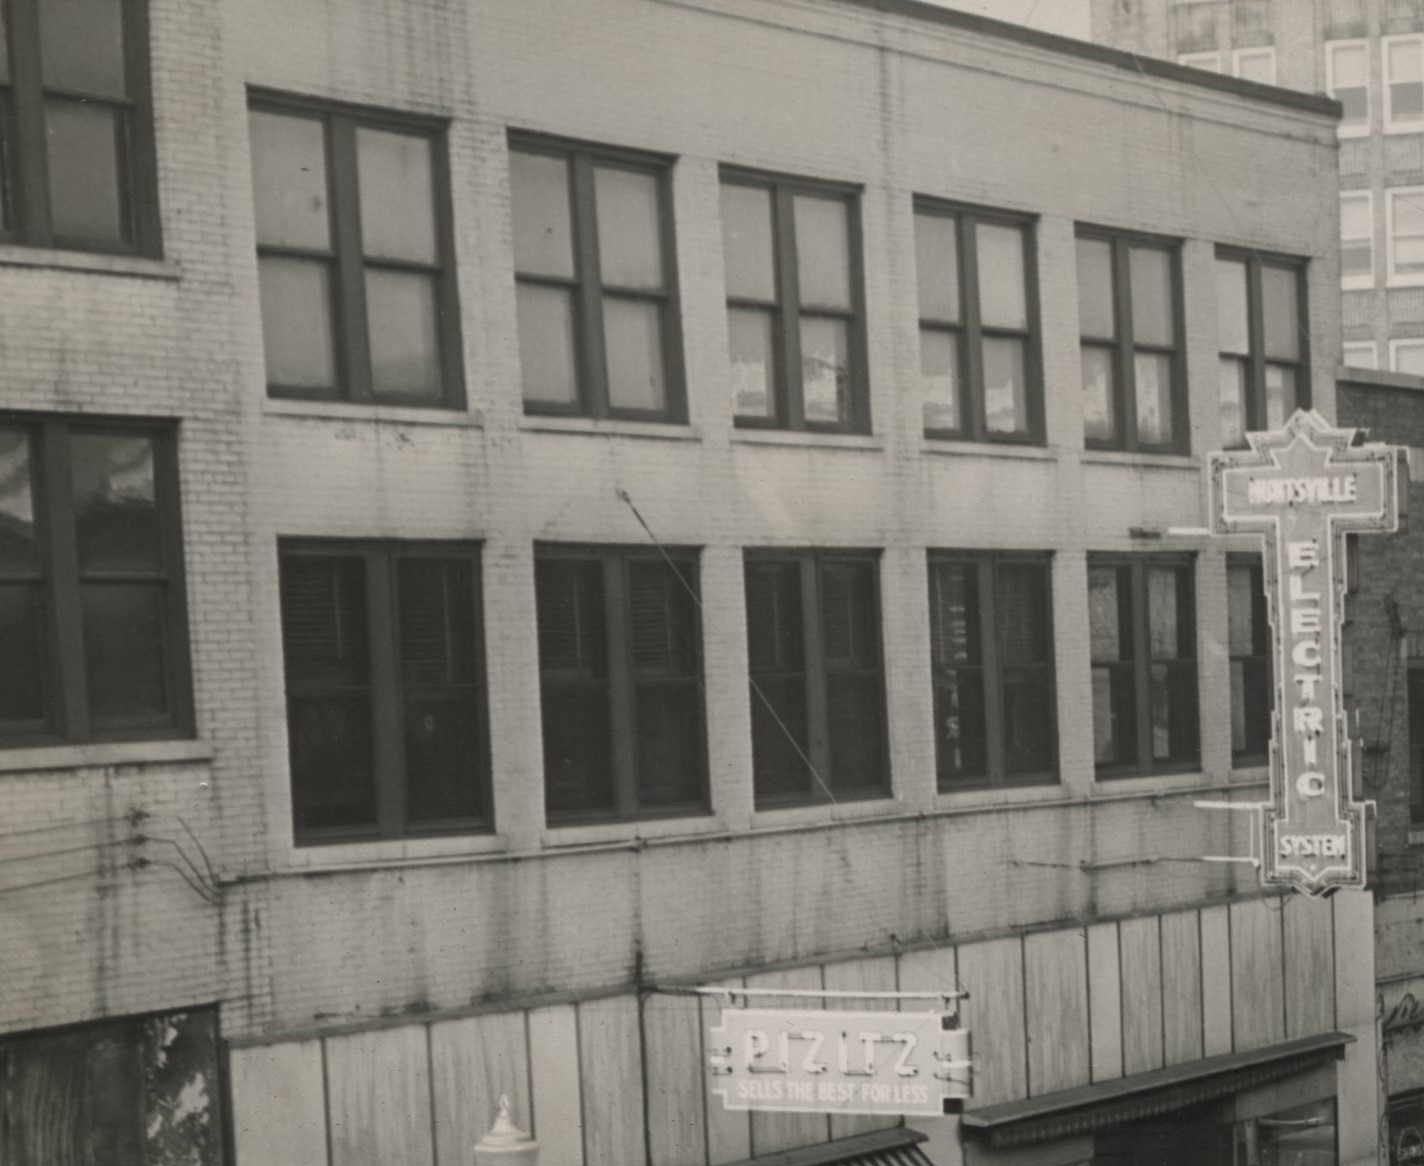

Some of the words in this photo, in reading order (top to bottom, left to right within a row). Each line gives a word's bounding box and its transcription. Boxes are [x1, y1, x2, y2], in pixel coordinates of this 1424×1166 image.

[1247, 475, 1357, 504] HUNTSVILLE
[1287, 540, 1325, 797] ELECTRIC
[1280, 834, 1345, 859] SYSTEM
[744, 1030, 919, 1077] PIZITZ
[738, 1079, 783, 1100] SELLS
[786, 1081, 813, 1101] THE
[817, 1082, 854, 1102] BEST
[862, 1083, 889, 1103] FOR
[894, 1084, 929, 1104] LESS
